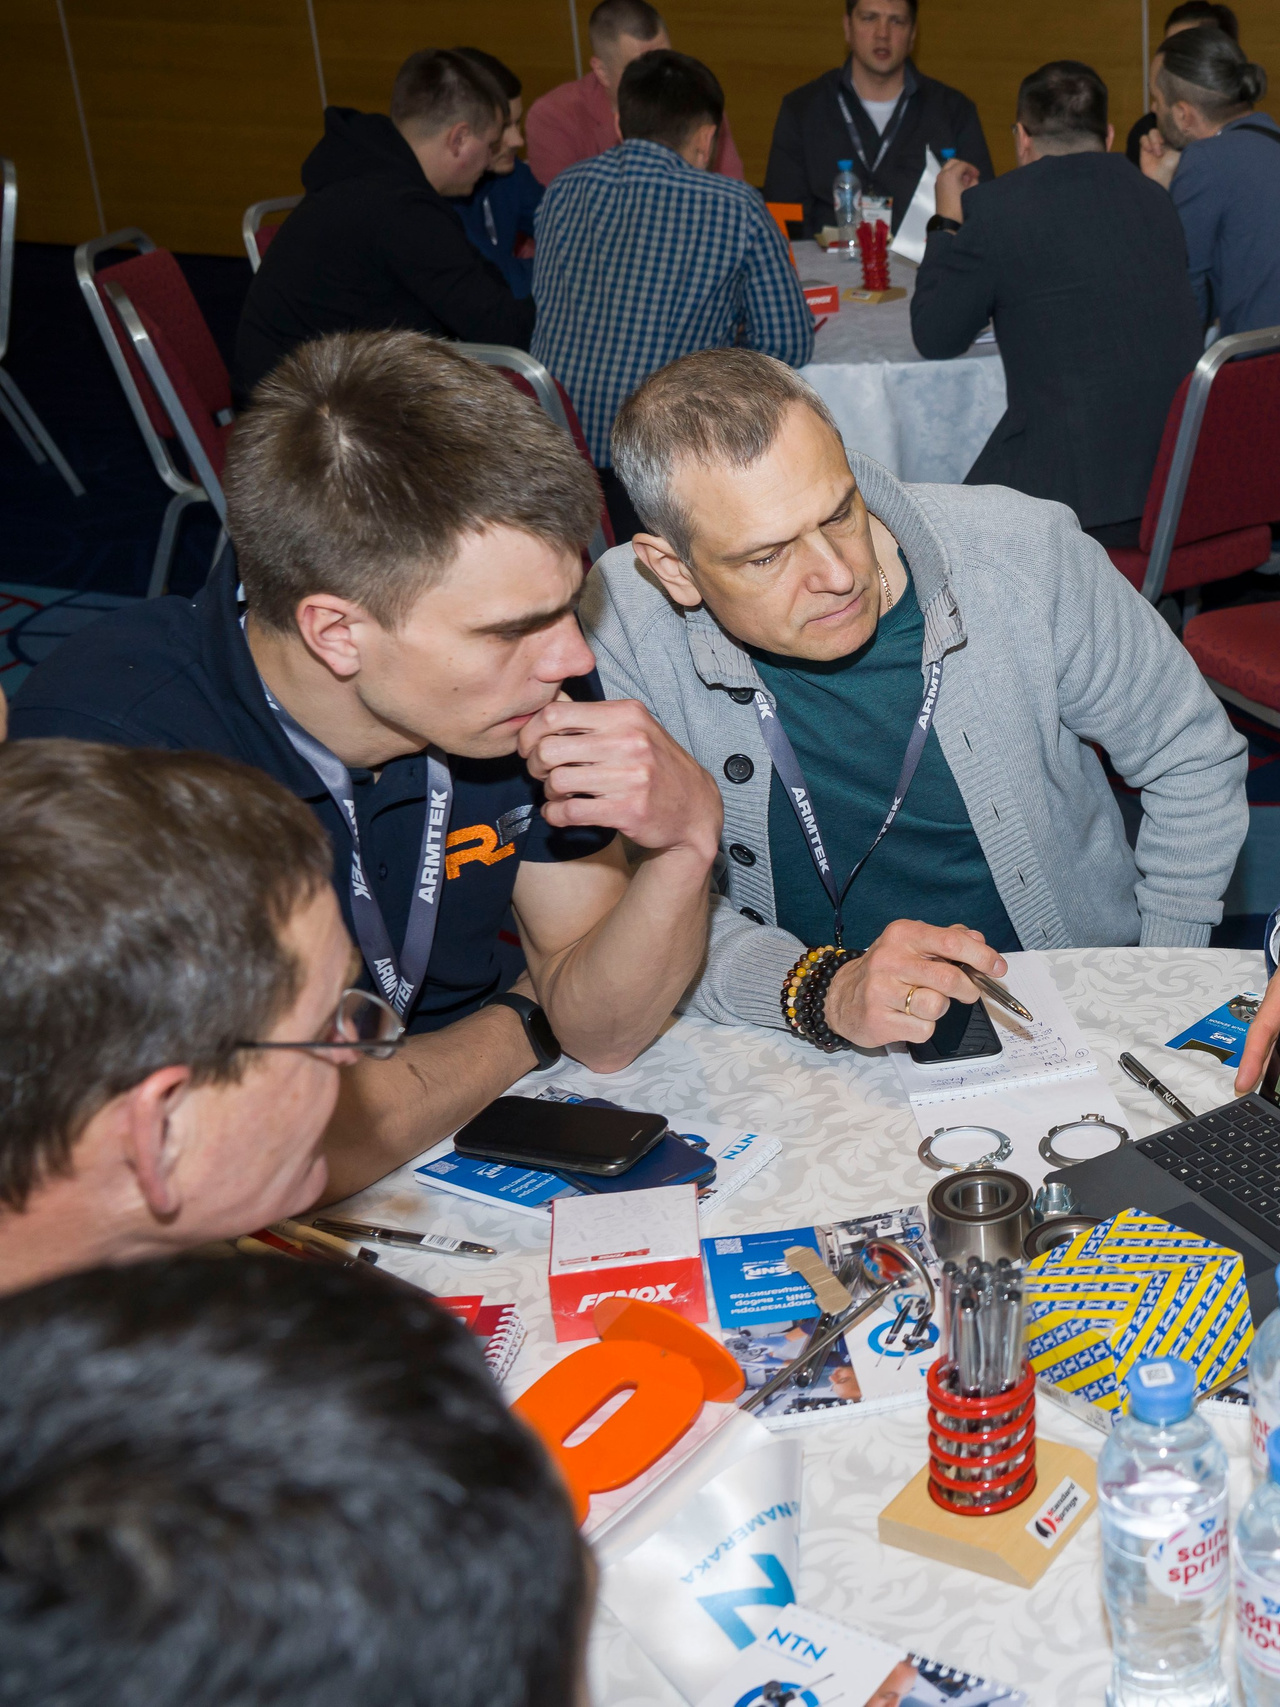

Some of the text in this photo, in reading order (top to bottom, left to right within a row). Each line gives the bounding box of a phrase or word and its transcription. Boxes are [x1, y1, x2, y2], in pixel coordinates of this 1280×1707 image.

[918, 660, 942, 731] ARMT
[418, 789, 449, 904] ARMTEK
[791, 786, 830, 875] ARMTEK
[1163, 1092, 1178, 1105] NTN
[722, 1133, 758, 1160] NTN
[680, 1501, 793, 1583] NAMERAKA
[1168, 1544, 1229, 1586] sprin
[767, 1626, 828, 1662] NTN
